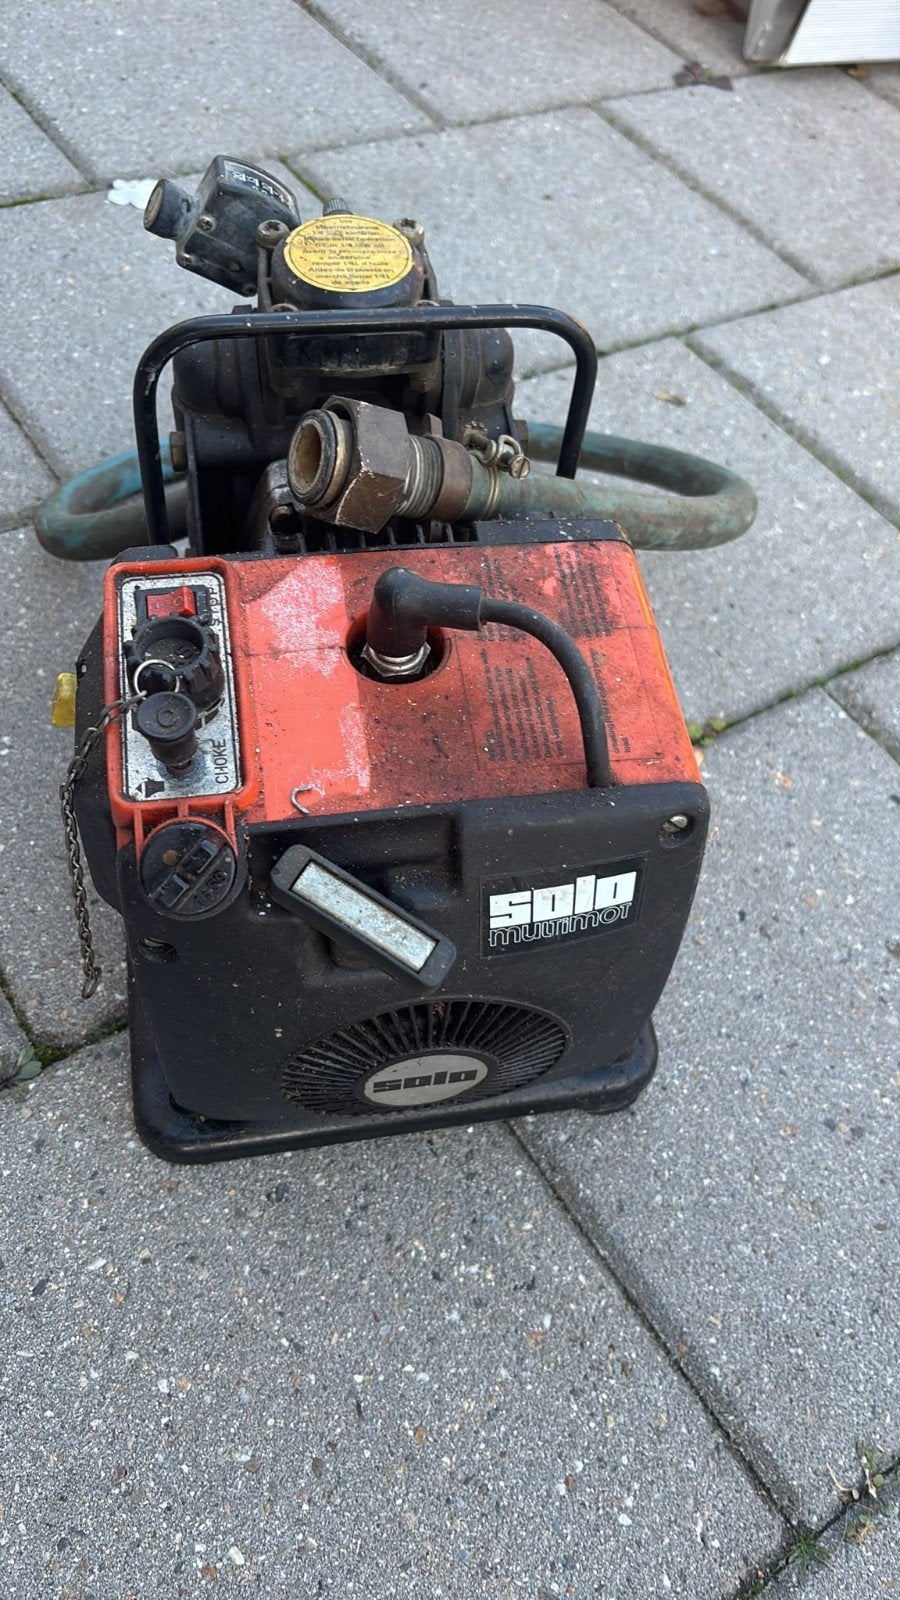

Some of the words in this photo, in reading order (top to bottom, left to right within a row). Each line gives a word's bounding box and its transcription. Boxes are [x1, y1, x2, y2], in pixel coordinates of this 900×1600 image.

[212, 738, 228, 785] CHOKE
[489, 871, 637, 929] solo
[489, 902, 633, 947] multimot
[372, 1068, 479, 1094] solo
